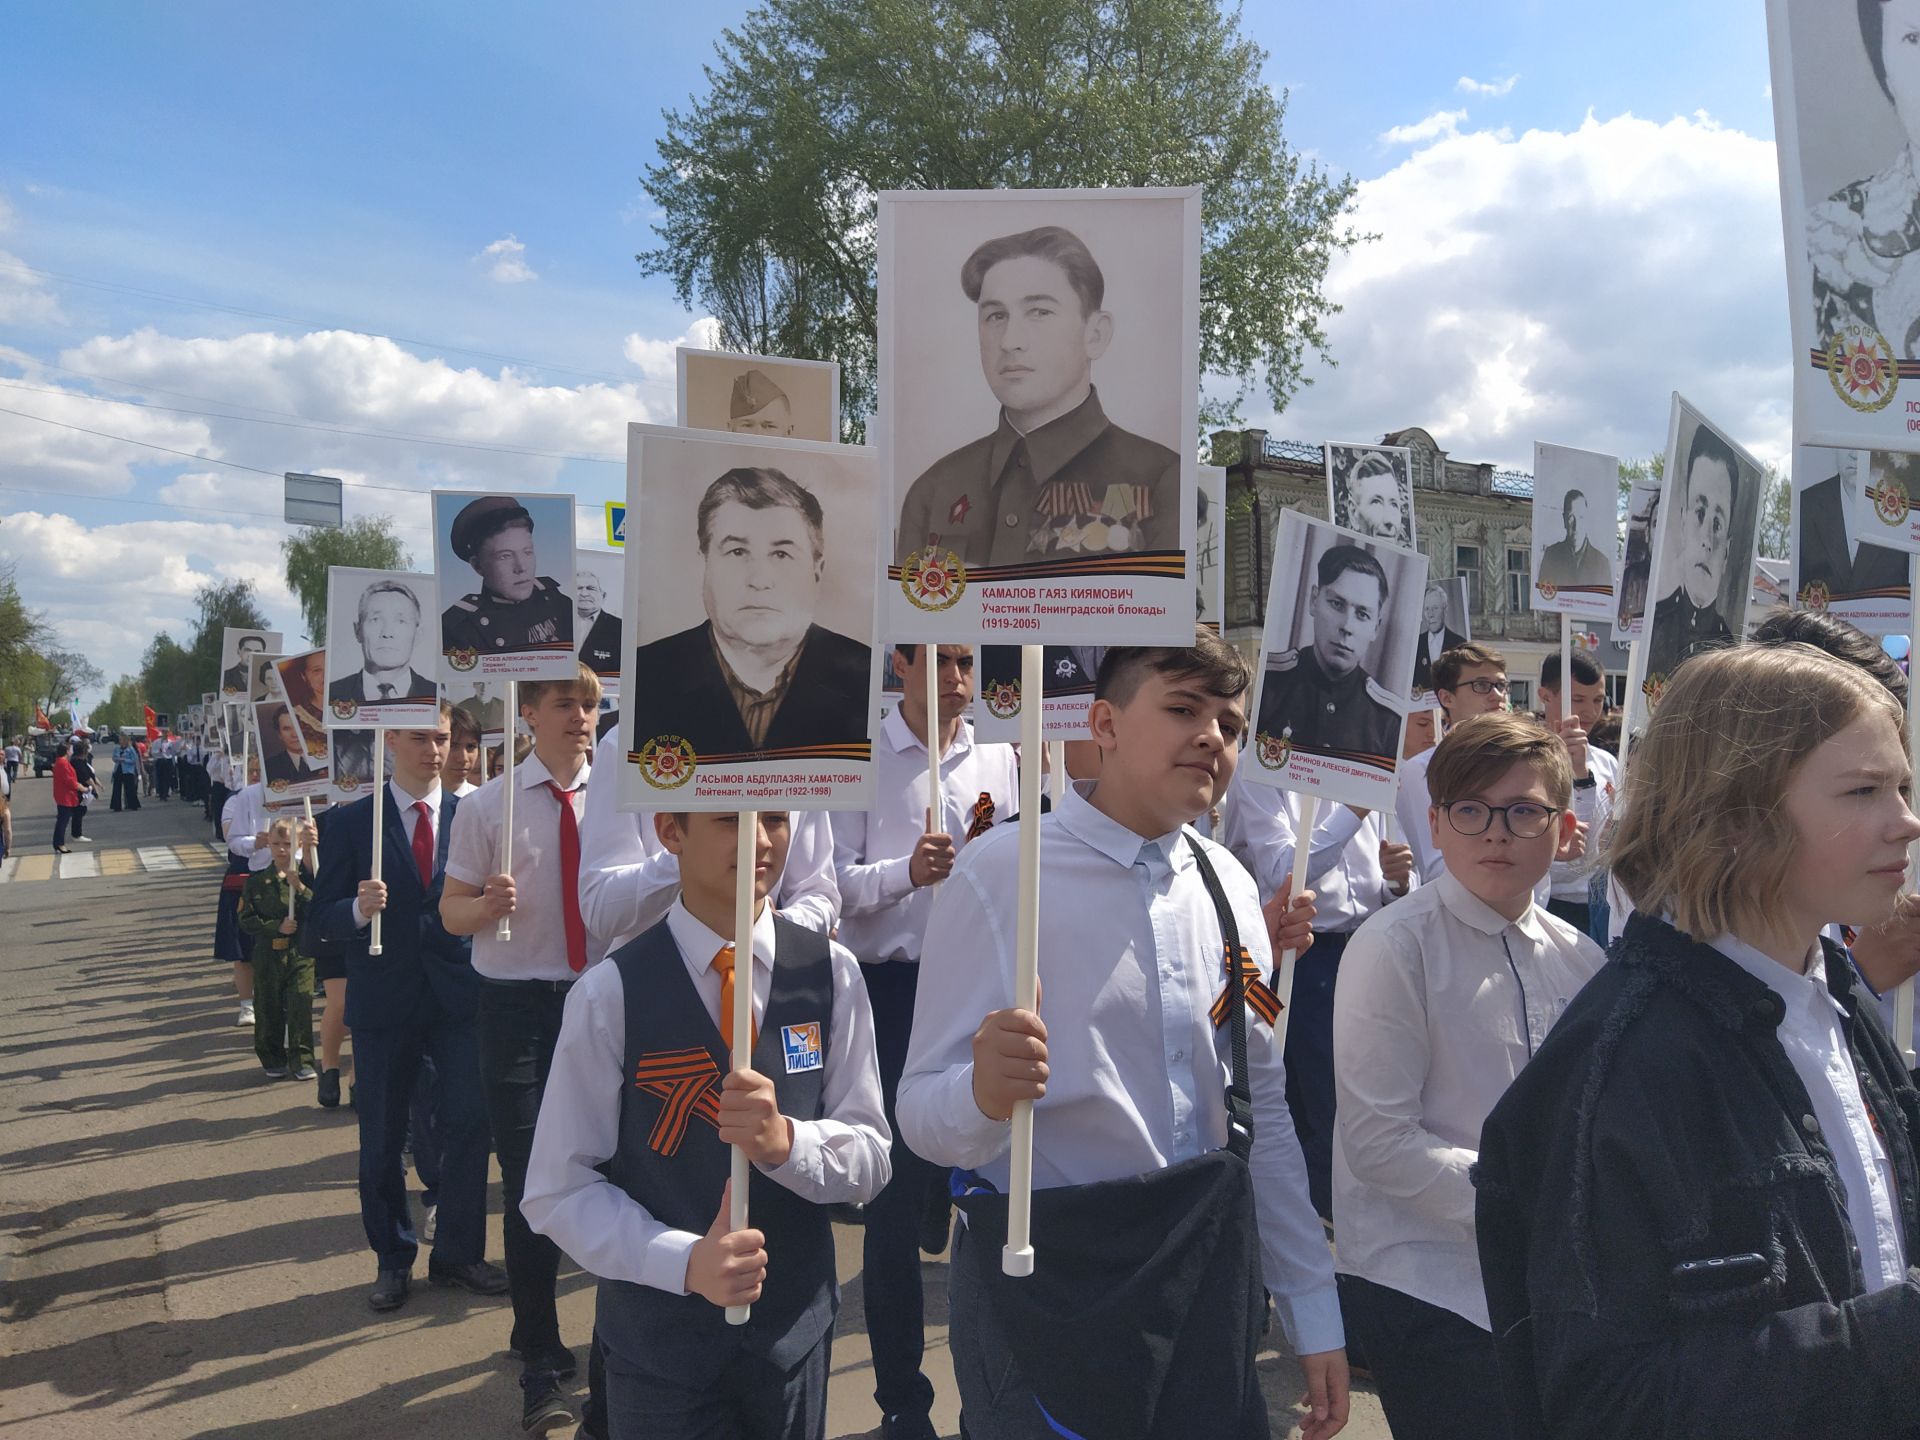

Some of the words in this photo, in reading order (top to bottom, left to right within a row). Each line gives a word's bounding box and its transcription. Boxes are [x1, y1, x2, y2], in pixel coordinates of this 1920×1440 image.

[982, 588, 1036, 599] КАМАЛОВ
[1040, 588, 1068, 599] ГАЯЗ
[1070, 588, 1133, 599] КИЯМОВИЧ
[982, 603, 1031, 614] Участник
[1033, 603, 1114, 616] Ленинградской
[1117, 604, 1166, 616] блокады
[982, 618, 1040, 630] (1919-2005)
[1057, 702, 1089, 710] АЛЕКСЕЙ
[1290, 763, 1314, 773] Капитан
[1290, 754, 1321, 766] БАРИНОВ
[1321, 763, 1350, 774] АЛЕКСЕЙ
[1350, 769, 1391, 783] ДМИТРИЕВИЧ
[696, 774, 744, 784] ГАСЫМОВ
[746, 774, 806, 785] АБДУЛЛАЗЯН
[808, 774, 862, 784] ХАМАТОВИЧ
[695, 787, 744, 797] Лейтенант,
[746, 787, 783, 797] медбрат
[785, 787, 831, 798] (1922-1998)
[788, 1049, 820, 1070] ЛИЦЕЙ
